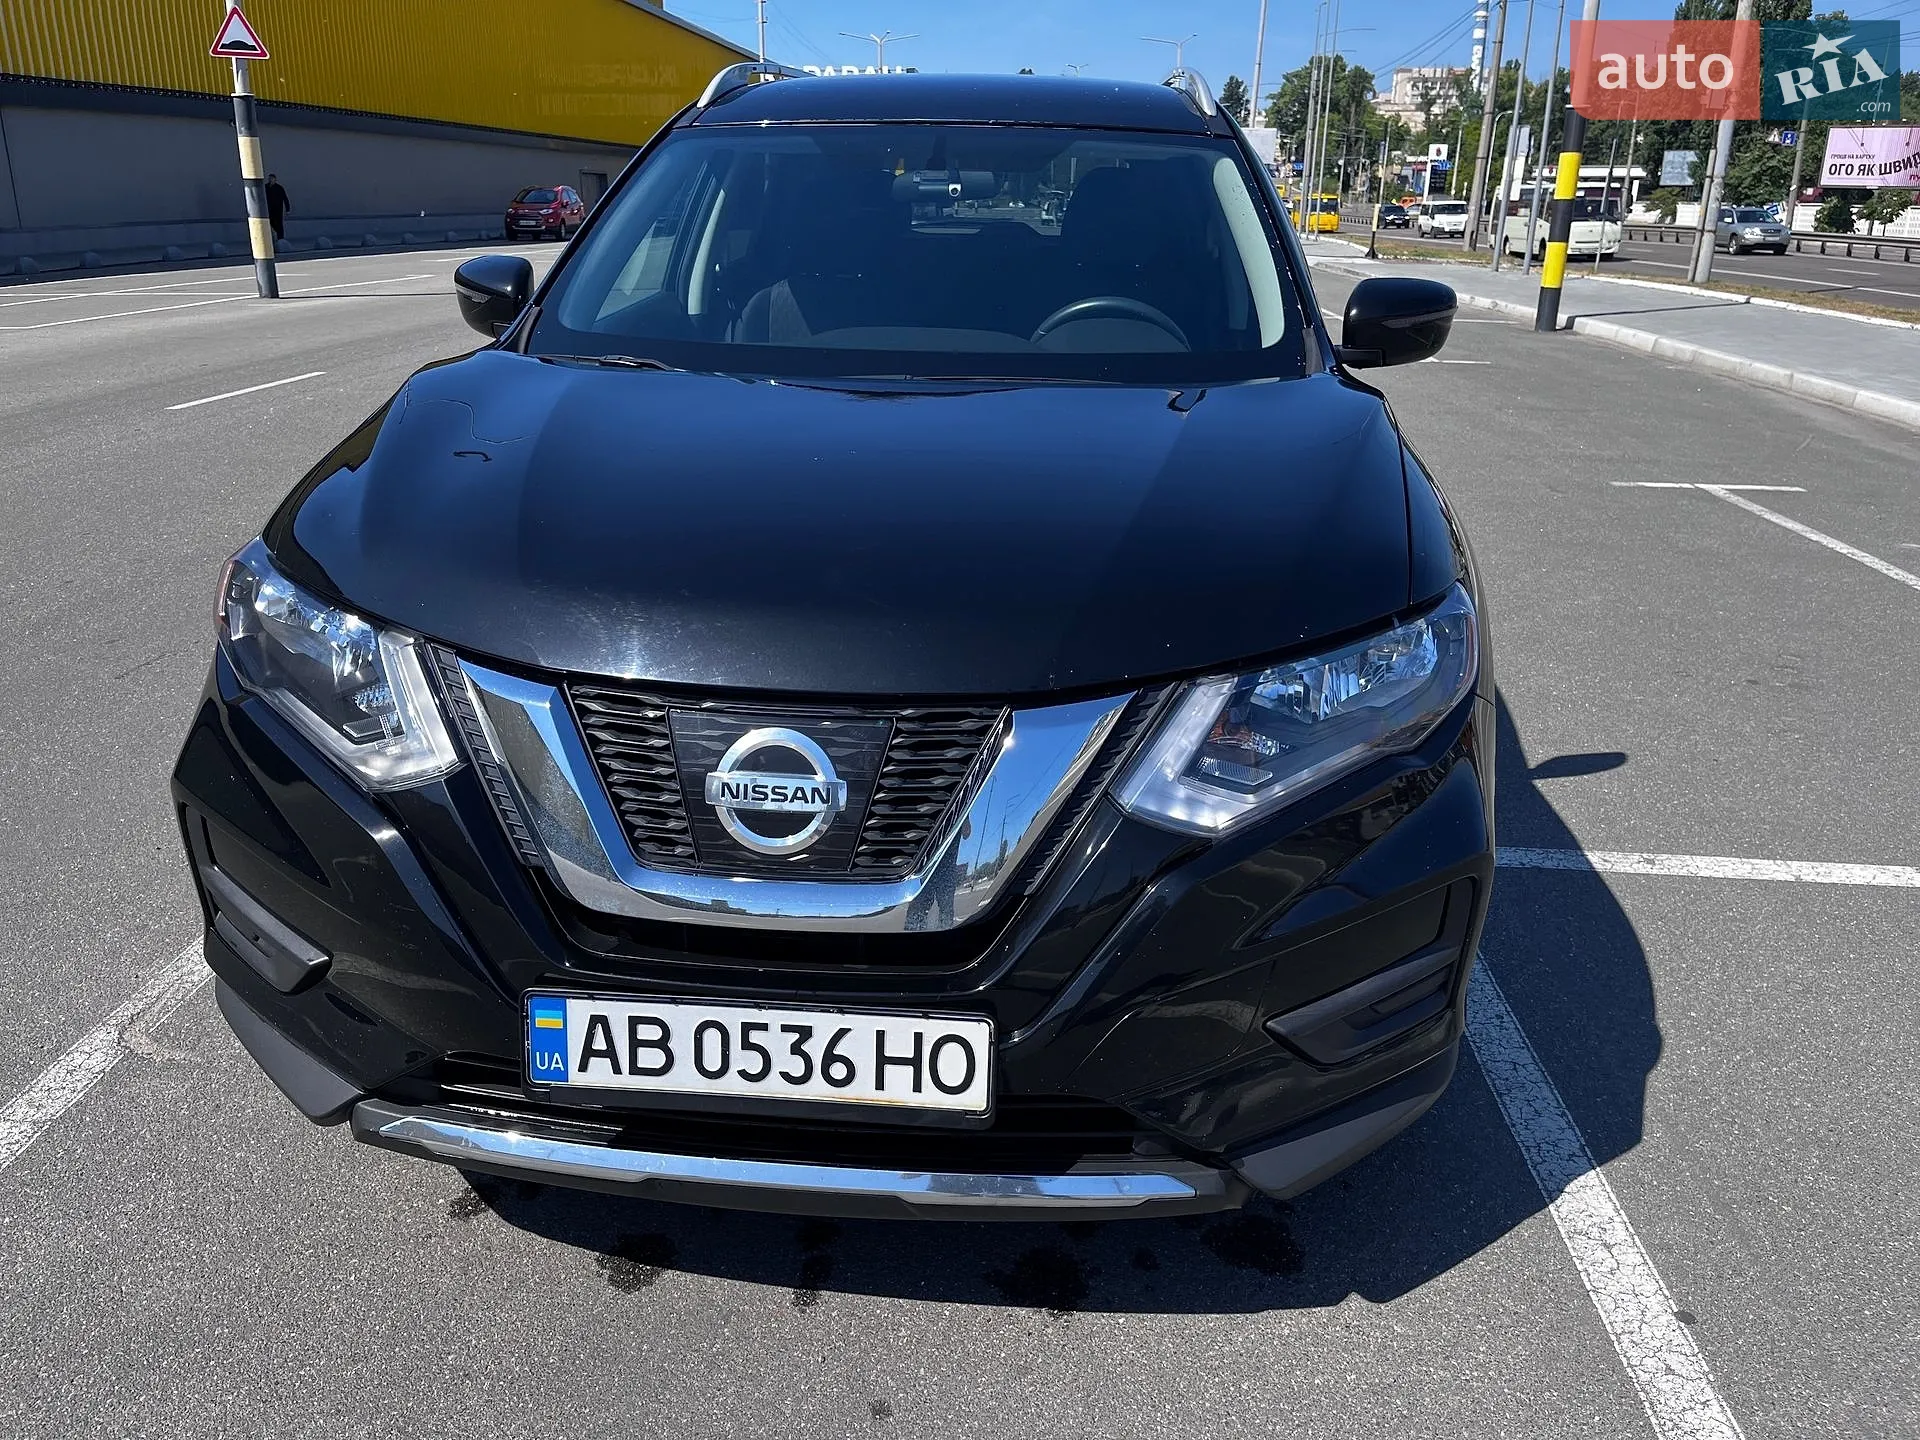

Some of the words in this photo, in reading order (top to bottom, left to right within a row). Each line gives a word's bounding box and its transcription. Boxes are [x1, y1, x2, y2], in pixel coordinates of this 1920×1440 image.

[1828, 163, 1854, 176] ОГО
[1857, 163, 1876, 176] ЯК
[720, 782, 831, 805] NISSAN
[536, 1051, 565, 1072] UA
[577, 1013, 675, 1077] AB
[693, 1019, 857, 1089] 0536
[874, 1029, 977, 1095] HO
